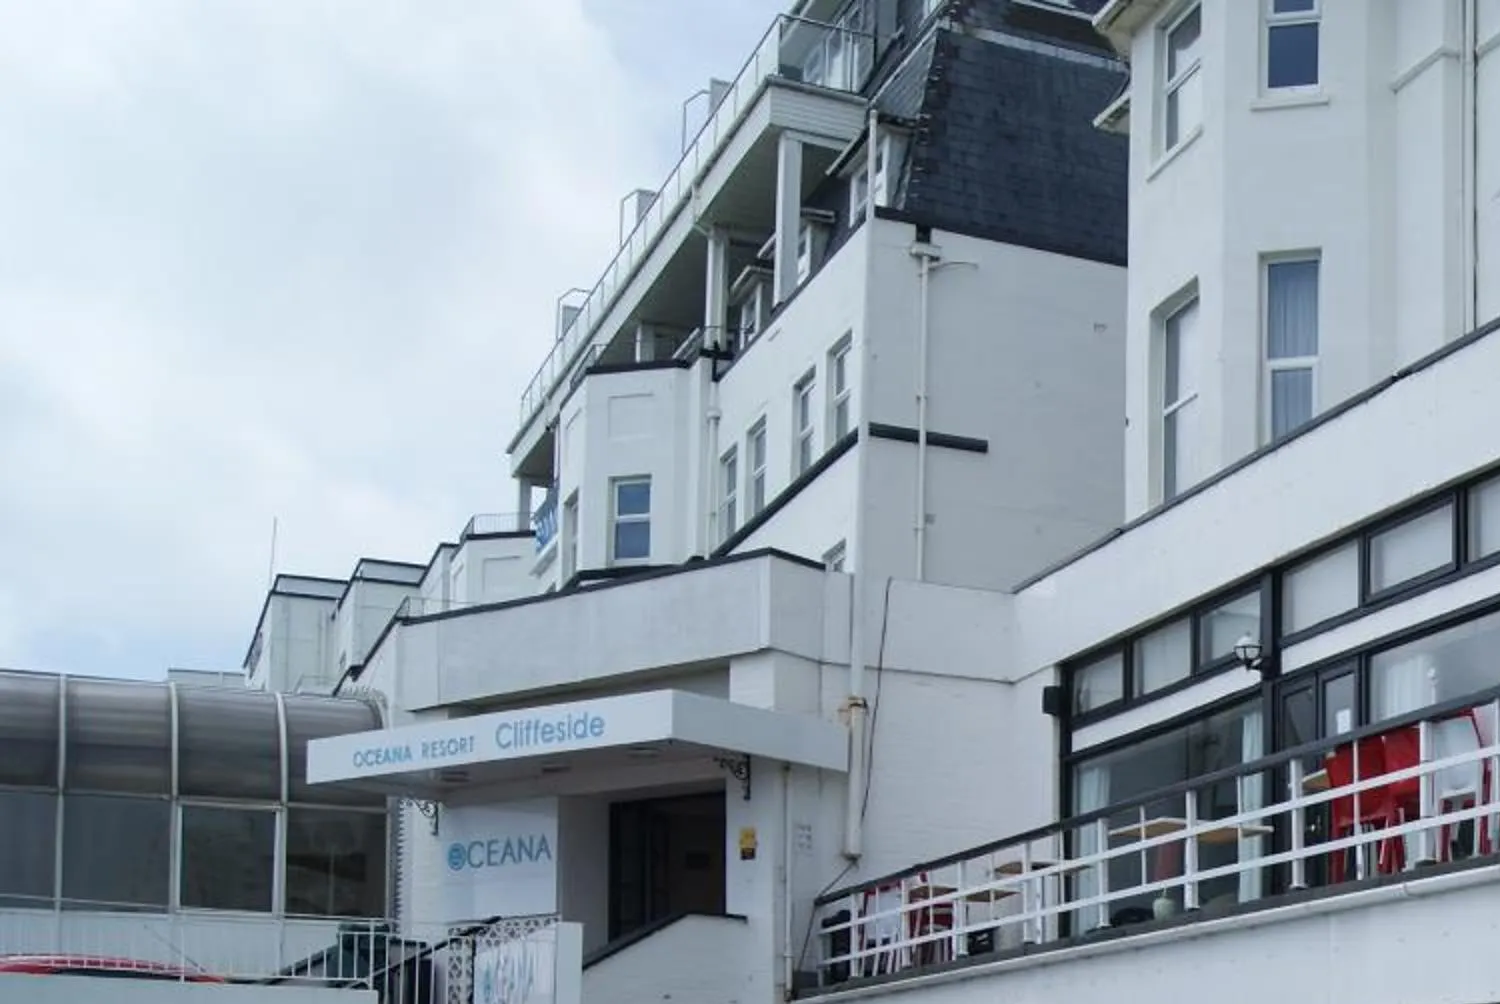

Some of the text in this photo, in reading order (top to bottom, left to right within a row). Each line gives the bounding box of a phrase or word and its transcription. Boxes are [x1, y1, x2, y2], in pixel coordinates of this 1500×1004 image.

[353, 712, 605, 768] OCEANA RESORT Cliffeside
